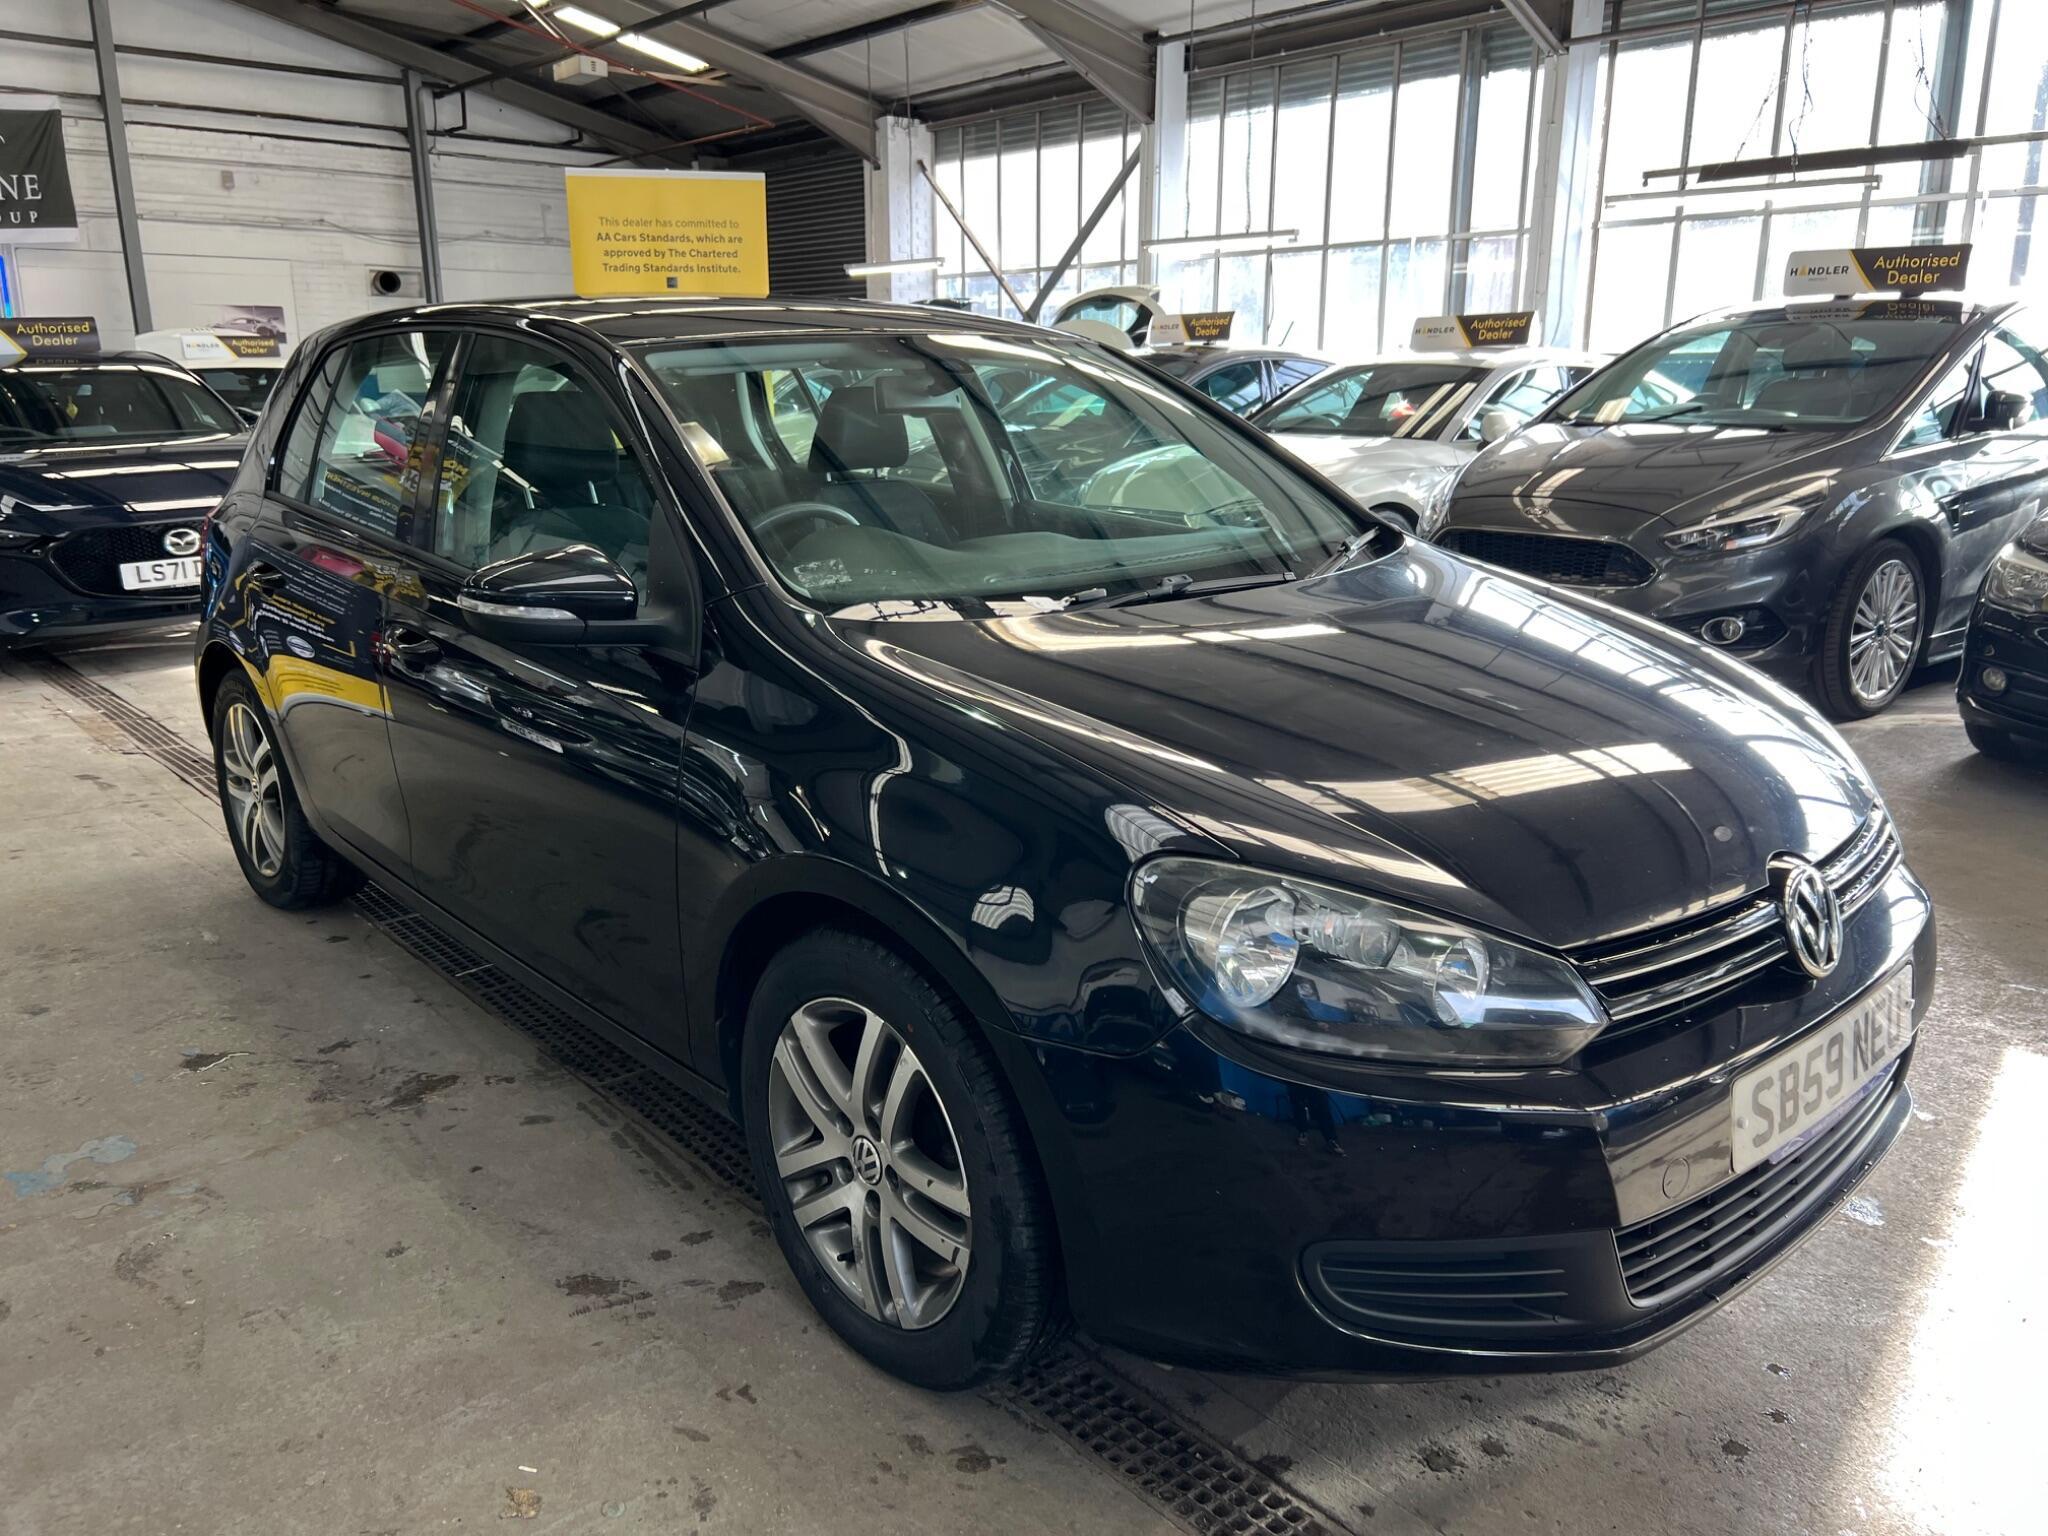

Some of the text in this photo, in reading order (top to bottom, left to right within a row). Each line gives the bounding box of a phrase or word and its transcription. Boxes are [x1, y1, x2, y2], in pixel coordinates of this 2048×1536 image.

[0, 210, 38, 223] UP
[599, 217, 740, 230] This dealer has committed to
[597, 232, 743, 244] AA Cars Standards, which are
[603, 249, 738, 259] approved by The Chartered
[1874, 252, 1960, 269] Authorised
[602, 263, 741, 274] Trading Standards Institute.
[1887, 271, 1940, 285] Dealer
[16, 321, 90, 334] Authorised
[1190, 317, 1230, 326] Authorised
[1471, 317, 1527, 329] Authorised
[1195, 327, 1219, 336] Dealer
[1478, 329, 1513, 340] Dealer
[32, 335, 78, 346] Dealer
[136, 561, 187, 583] LS71
[1752, 1032, 1844, 1148] SB59
